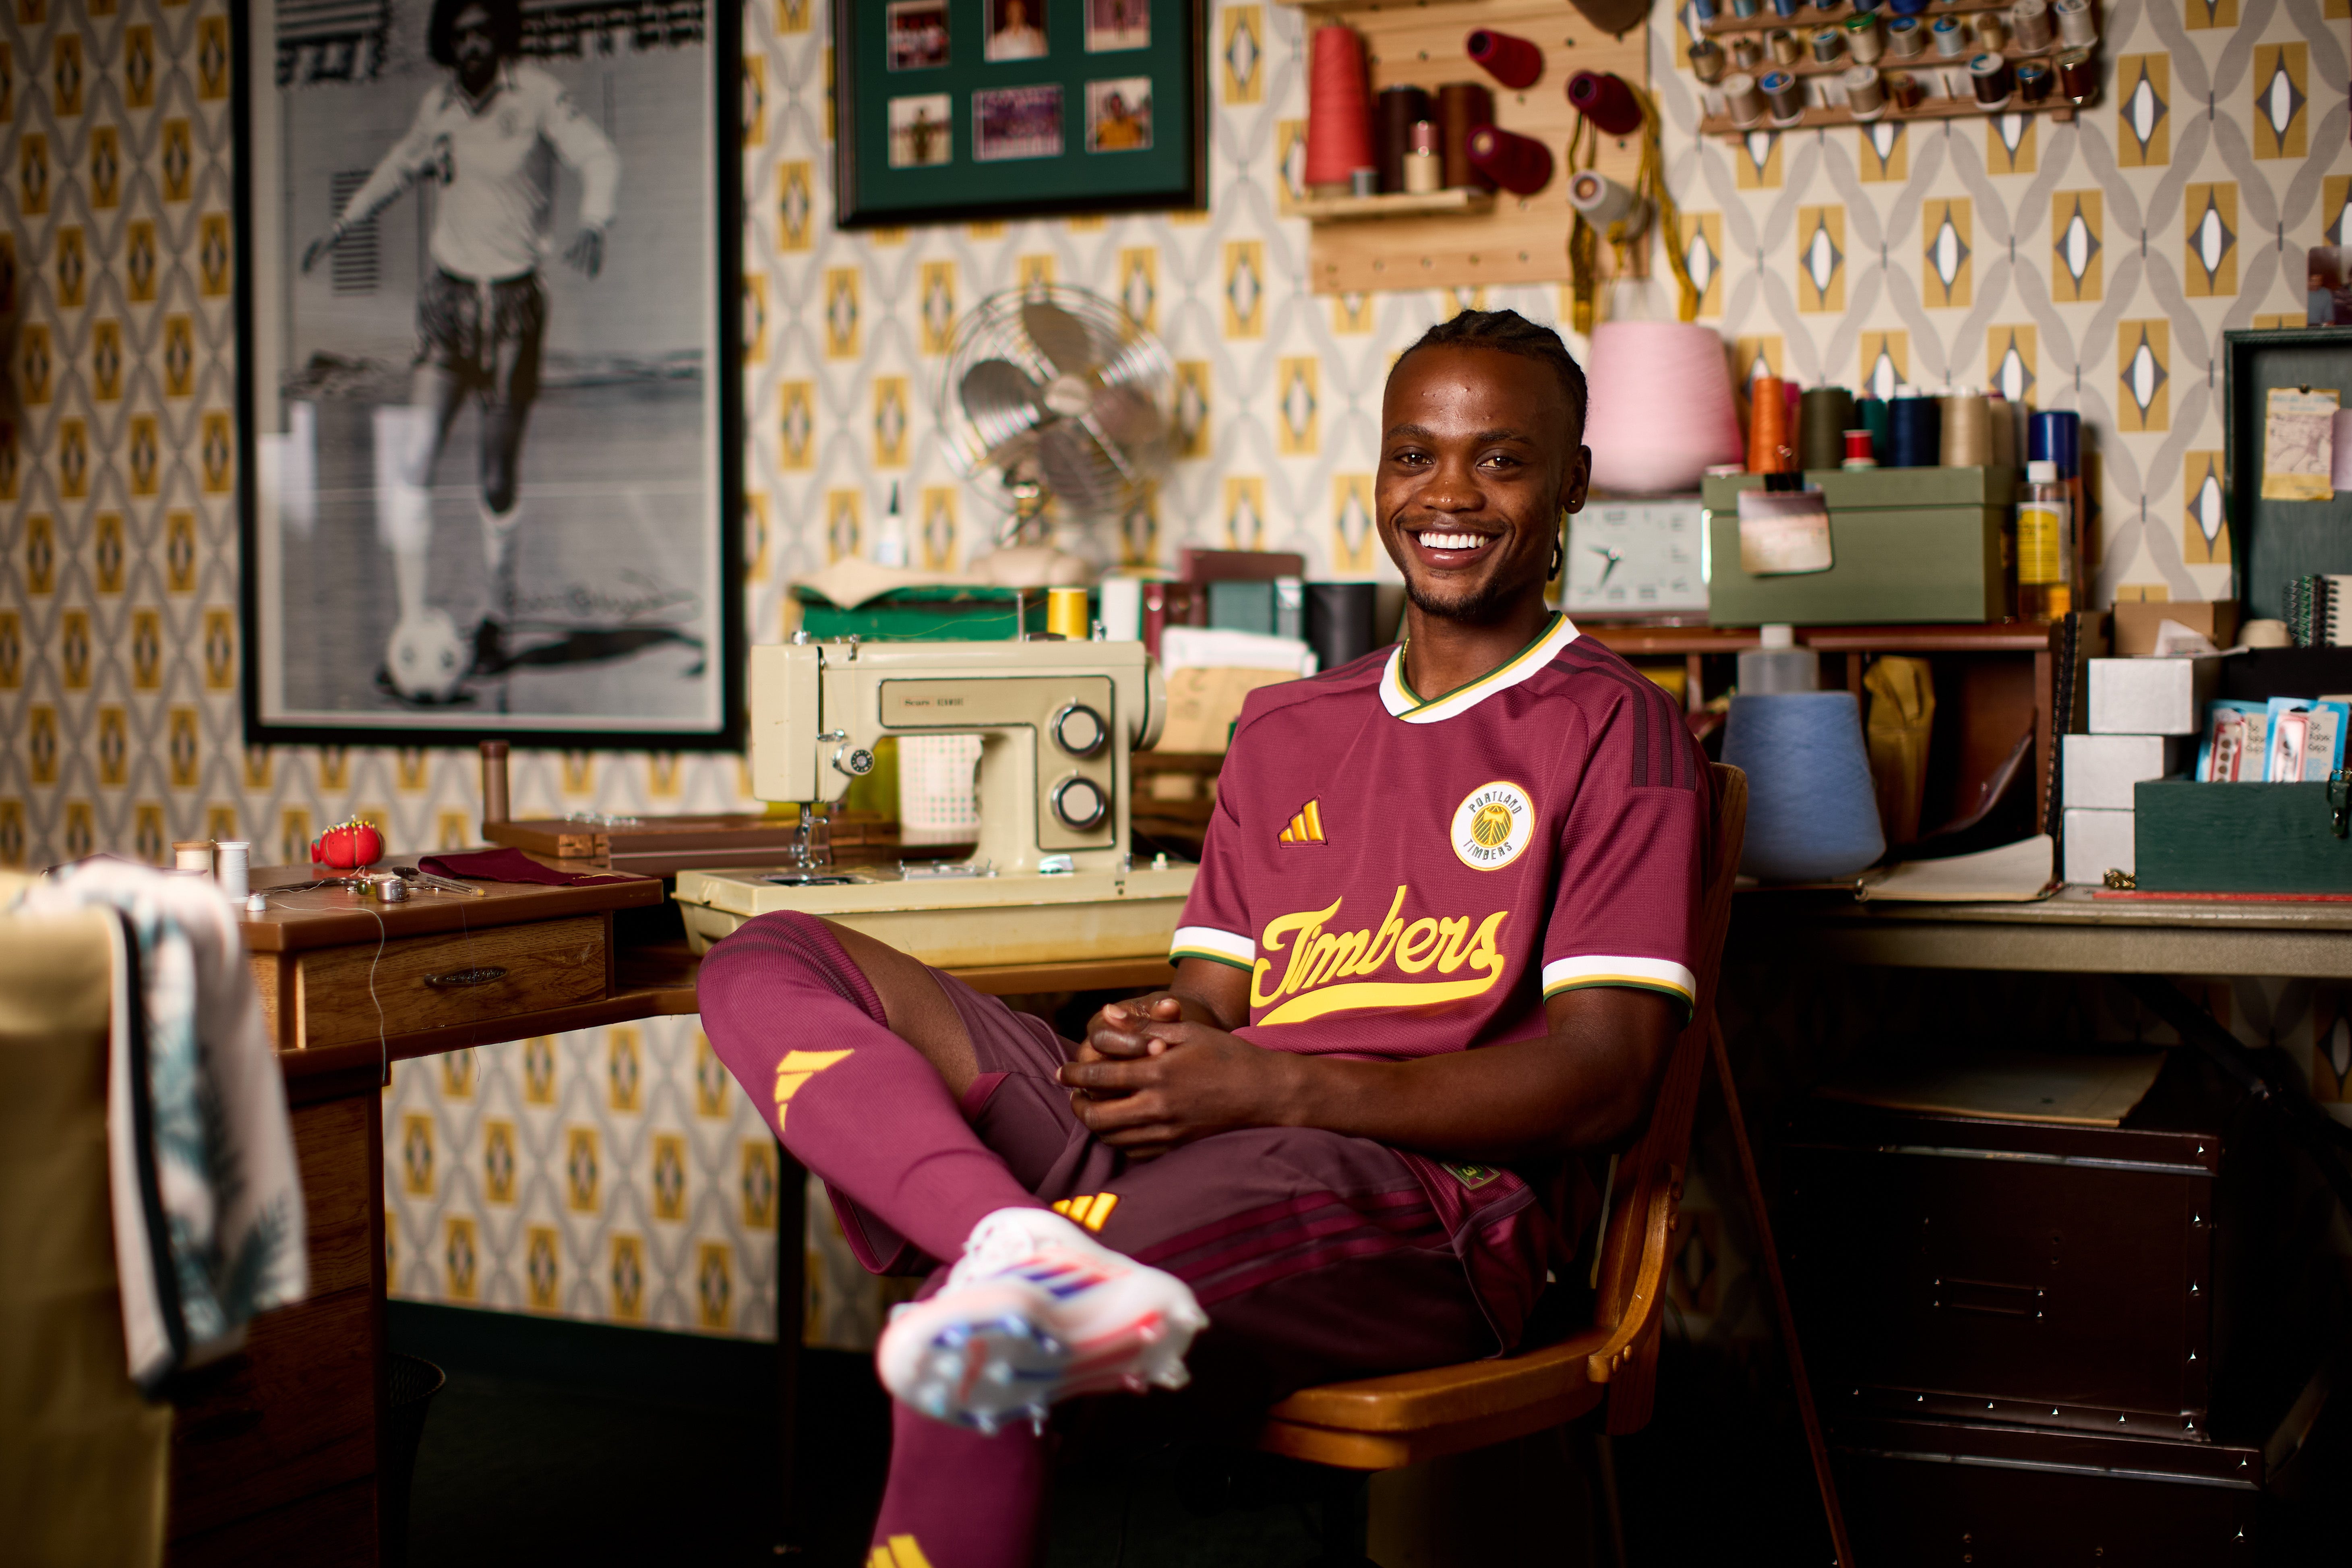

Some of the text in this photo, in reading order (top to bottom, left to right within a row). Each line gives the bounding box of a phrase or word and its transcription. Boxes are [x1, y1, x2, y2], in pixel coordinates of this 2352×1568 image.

[1468, 791, 1522, 815] PORTLAND
[1463, 838, 1512, 860] TIMBERS
[1249, 885, 1508, 1011] Timbers
